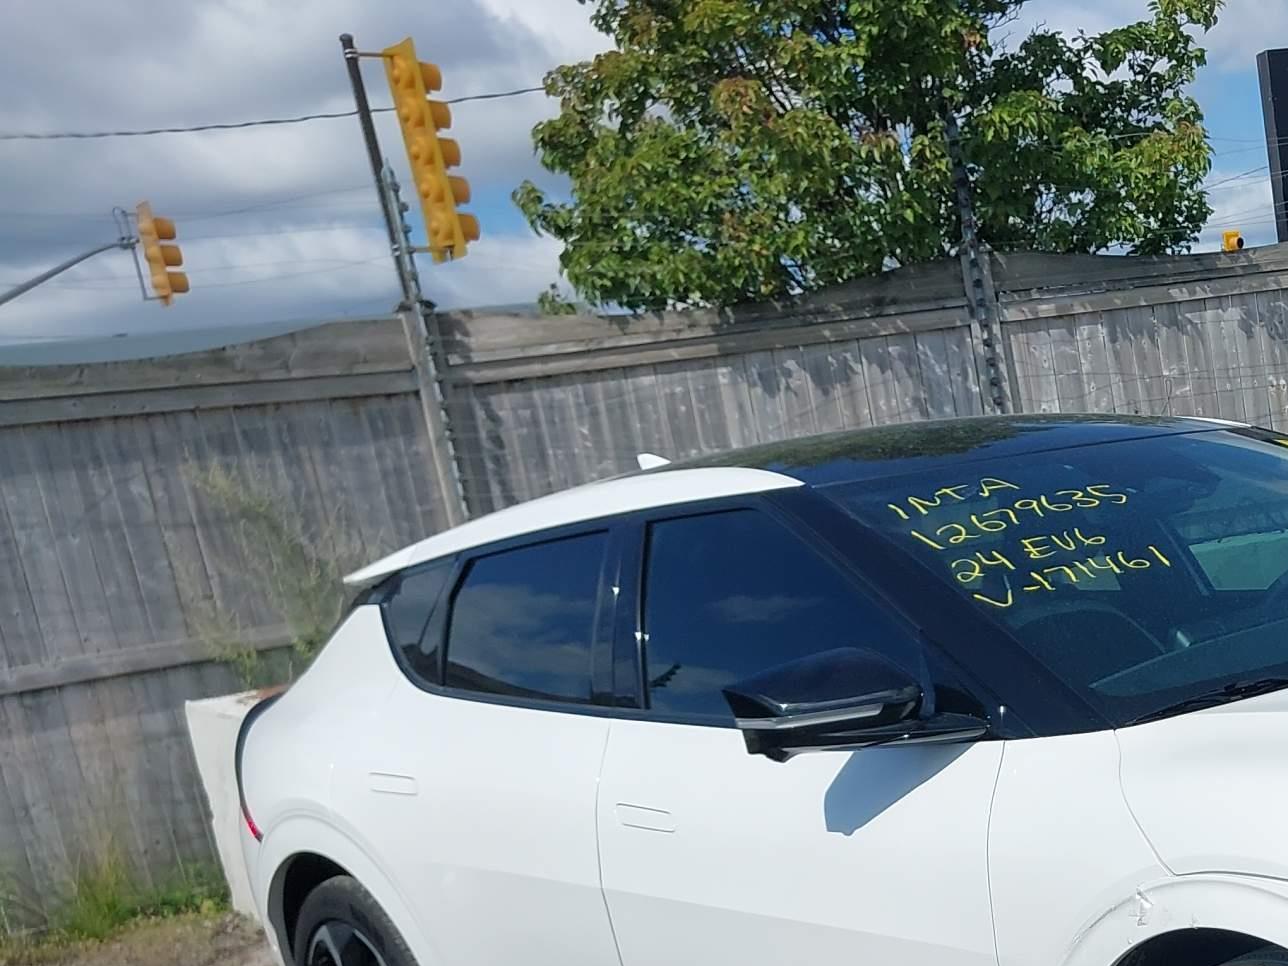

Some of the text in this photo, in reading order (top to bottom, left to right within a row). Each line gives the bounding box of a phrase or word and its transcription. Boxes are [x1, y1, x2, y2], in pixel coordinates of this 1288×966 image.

[911, 484, 1127, 549] 12679635
[951, 528, 1106, 582] 24 EV6
